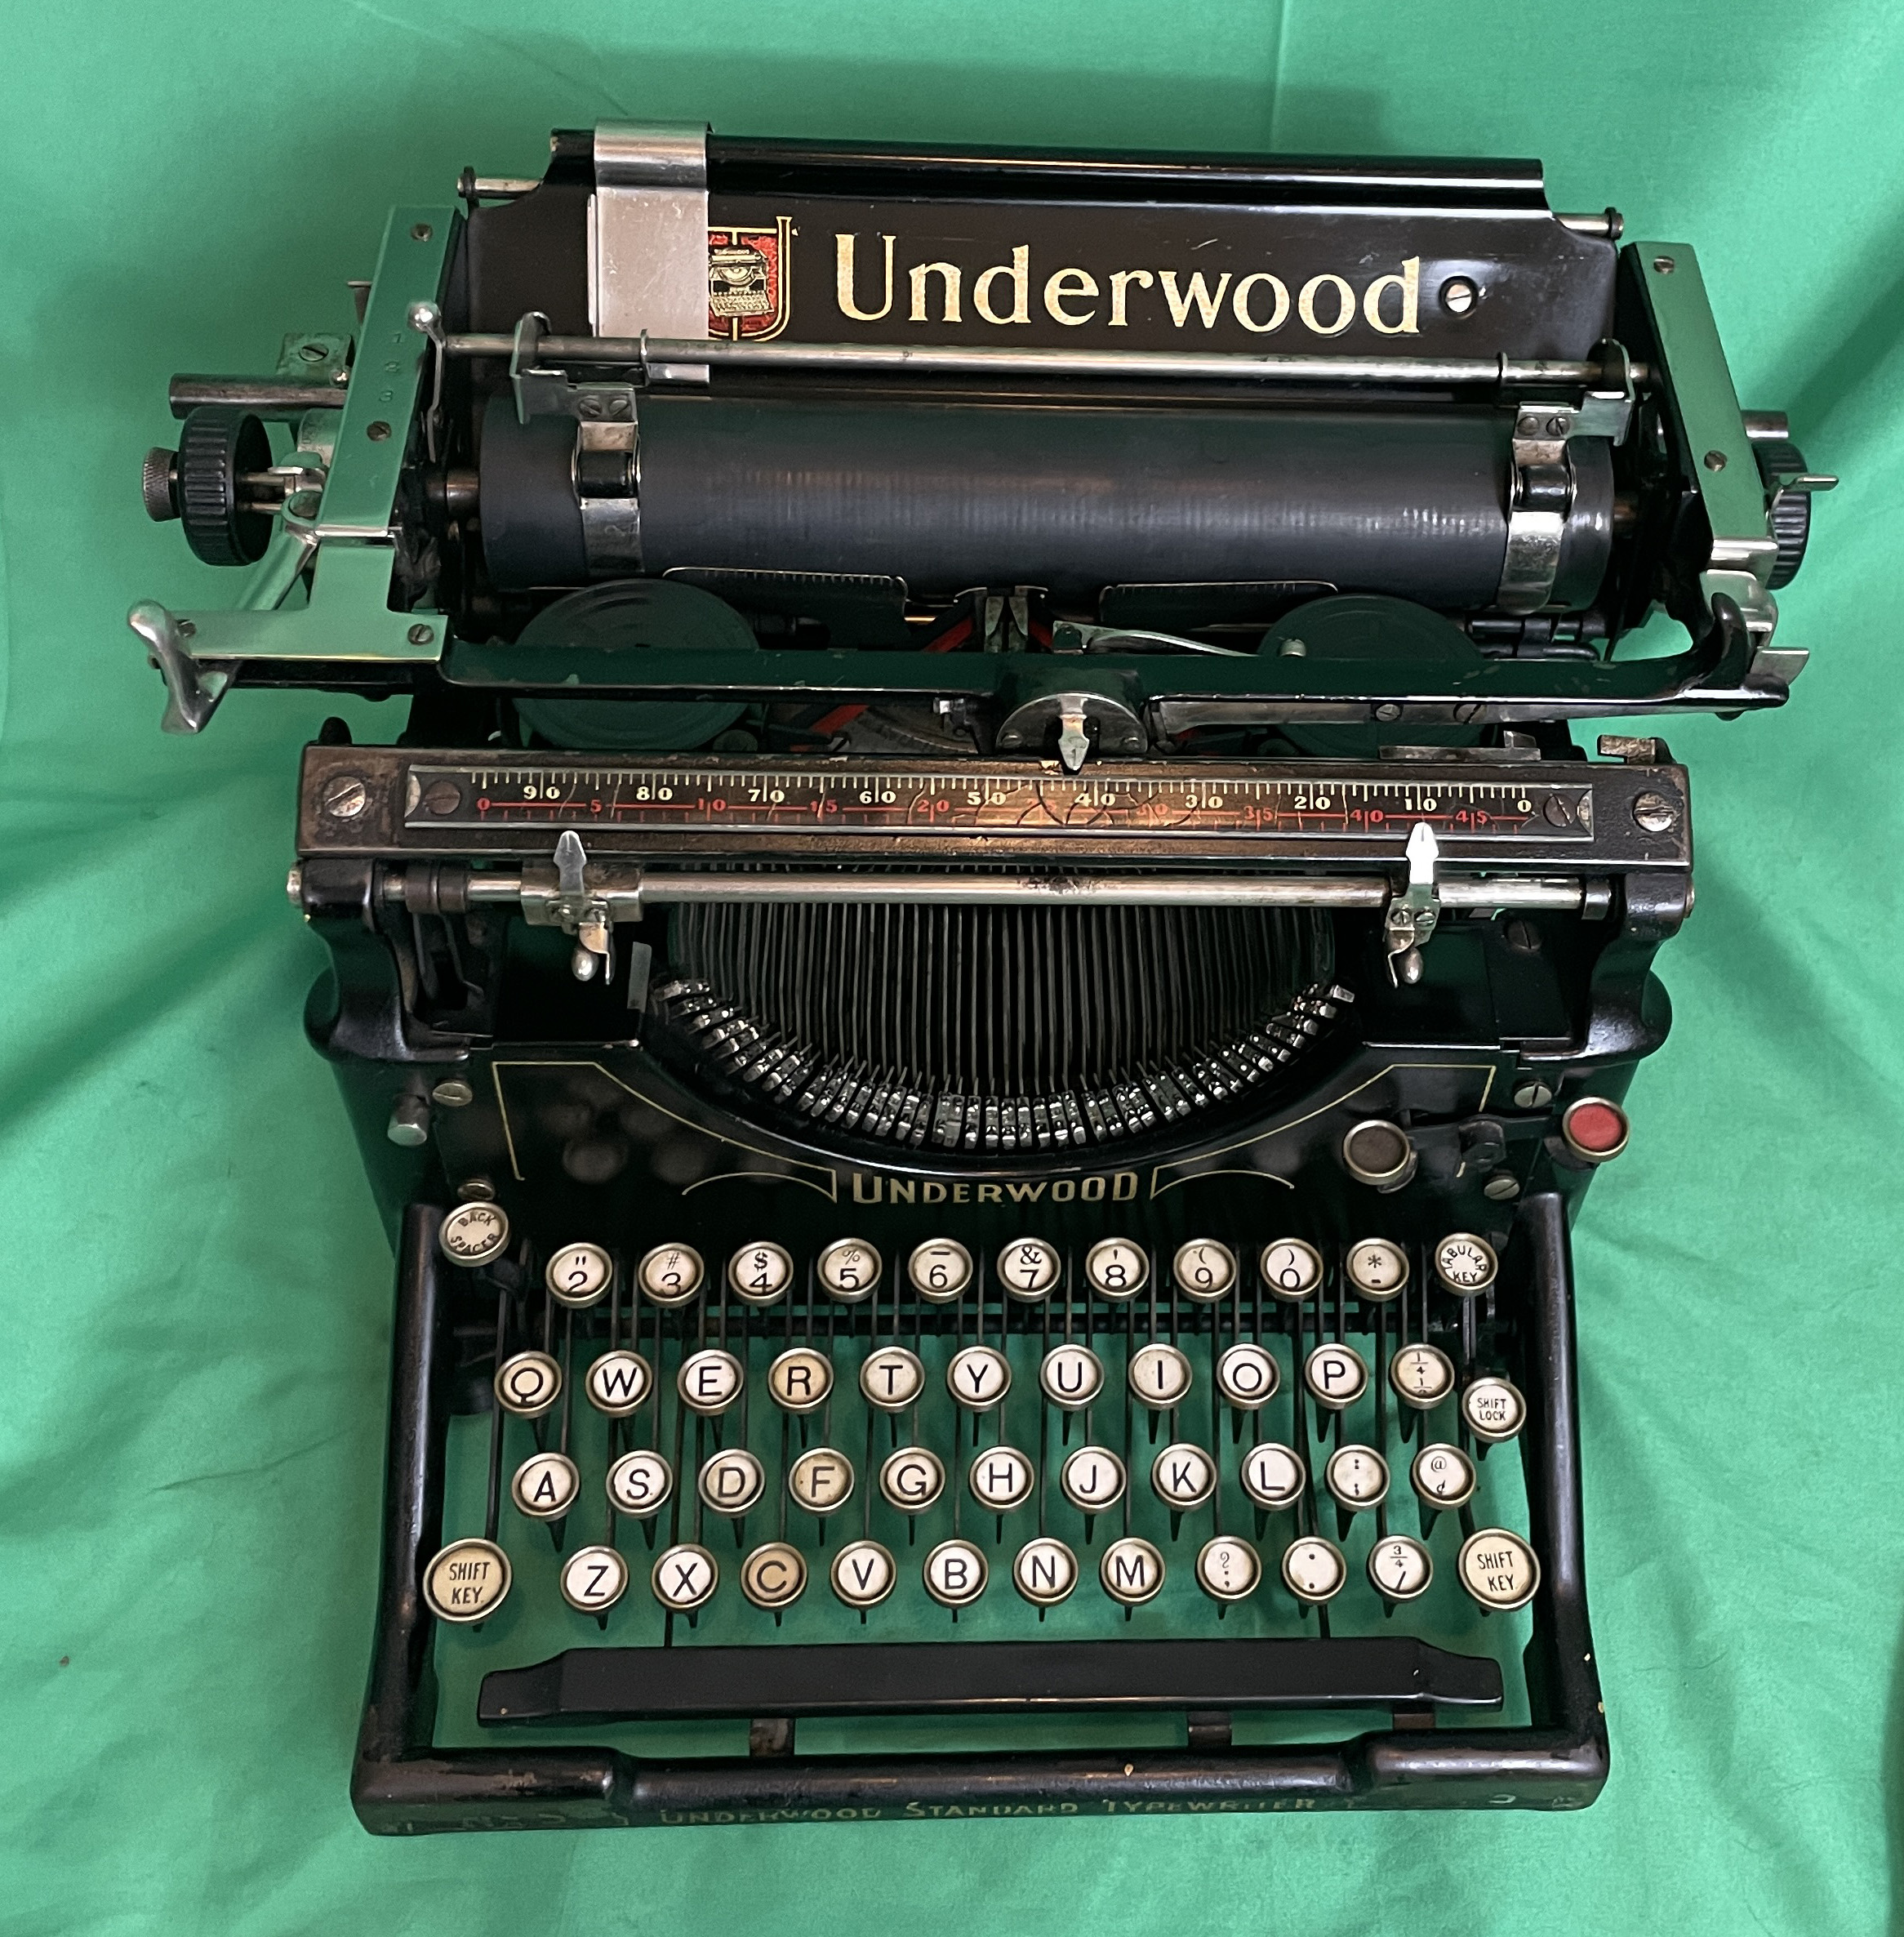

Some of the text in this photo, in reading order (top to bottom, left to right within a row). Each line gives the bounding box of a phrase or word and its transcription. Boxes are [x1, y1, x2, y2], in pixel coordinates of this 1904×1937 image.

[835, 234, 1421, 335] Underwood
[589, 799, 603, 813] 5
[852, 1171, 1138, 1205] UNDERWOOD
[457, 1212, 496, 1227] BACK
[567, 1270, 589, 1294] 2
[661, 1272, 683, 1296] 3
[749, 1272, 773, 1294] 4
[839, 1267, 861, 1291] 5
[929, 1264, 948, 1289] 6
[1019, 1268, 1039, 1289] 7
[1105, 1264, 1127, 1288] 8
[1194, 1267, 1214, 1289] 9
[1452, 1271, 1479, 1284] KEY
[510, 1366, 545, 1405] Q
[603, 1367, 638, 1398] W
[698, 1366, 723, 1396] E
[787, 1366, 812, 1396] R
[879, 1365, 904, 1395] T
[967, 1364, 989, 1393] Y
[1057, 1362, 1083, 1393] U
[1157, 1360, 1163, 1390] I
[1233, 1363, 1262, 1392] O
[1323, 1360, 1346, 1390] P
[1478, 1397, 1506, 1409] SHIFT
[1479, 1410, 1506, 1422] LOCK
[533, 1471, 557, 1503] A
[626, 1469, 650, 1500] S
[718, 1467, 745, 1498] D
[811, 1466, 835, 1498] F
[896, 1463, 928, 1497] G
[989, 1463, 1013, 1493] H
[1079, 1464, 1097, 1494] J
[1172, 1461, 1197, 1494] K
[1260, 1461, 1286, 1492] L
[449, 1561, 491, 1581] SHIFT
[852, 1558, 874, 1590] V
[944, 1558, 968, 1590] B
[1031, 1555, 1056, 1588] N
[1114, 1555, 1146, 1587] M
[1476, 1551, 1514, 1570] SHIFT
[584, 1565, 609, 1596] Z
[673, 1562, 698, 1596] X
[756, 1560, 787, 1593] C
[1487, 1574, 1515, 1592] KEY
[451, 1586, 483, 1605] KEY
